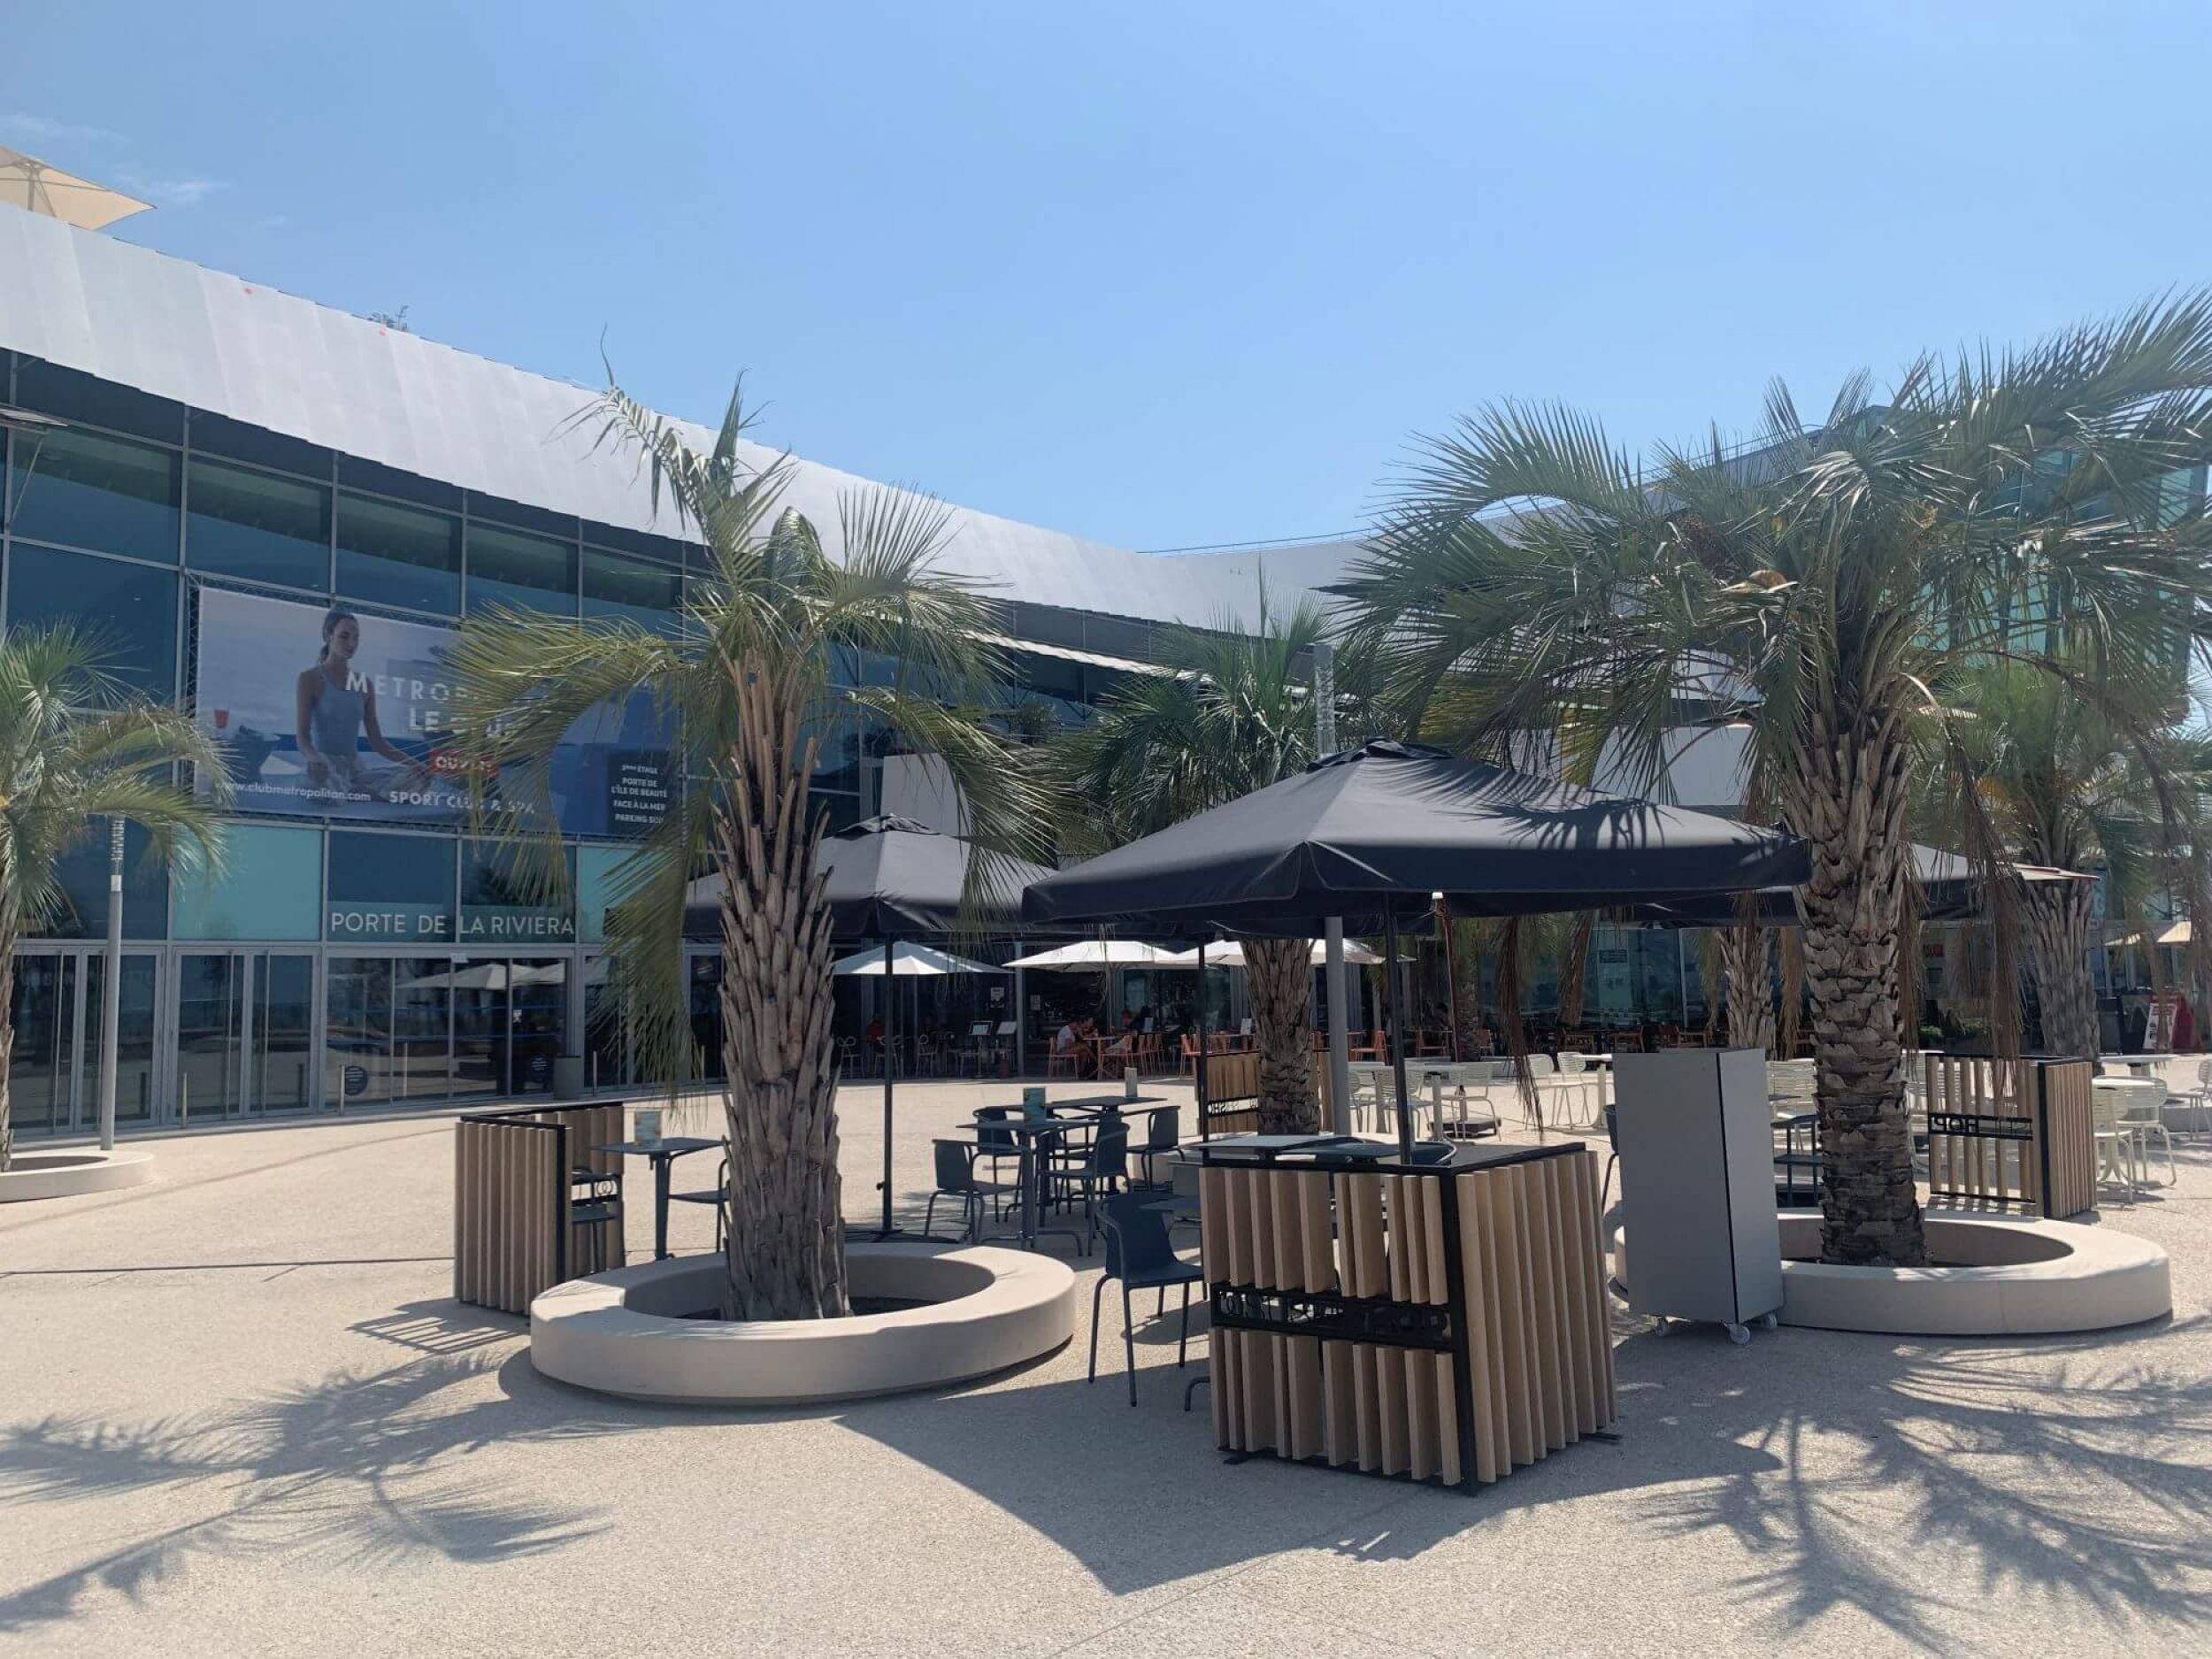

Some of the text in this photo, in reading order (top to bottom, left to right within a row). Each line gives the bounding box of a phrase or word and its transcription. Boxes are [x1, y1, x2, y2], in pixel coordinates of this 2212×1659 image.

[409, 707, 441, 732] LE
[622, 777, 646, 787] PORTE
[389, 790, 441, 806] SPORT
[614, 800, 632, 809] FACE
[331, 912, 574, 935] PORTE DE LA RIVIERA
